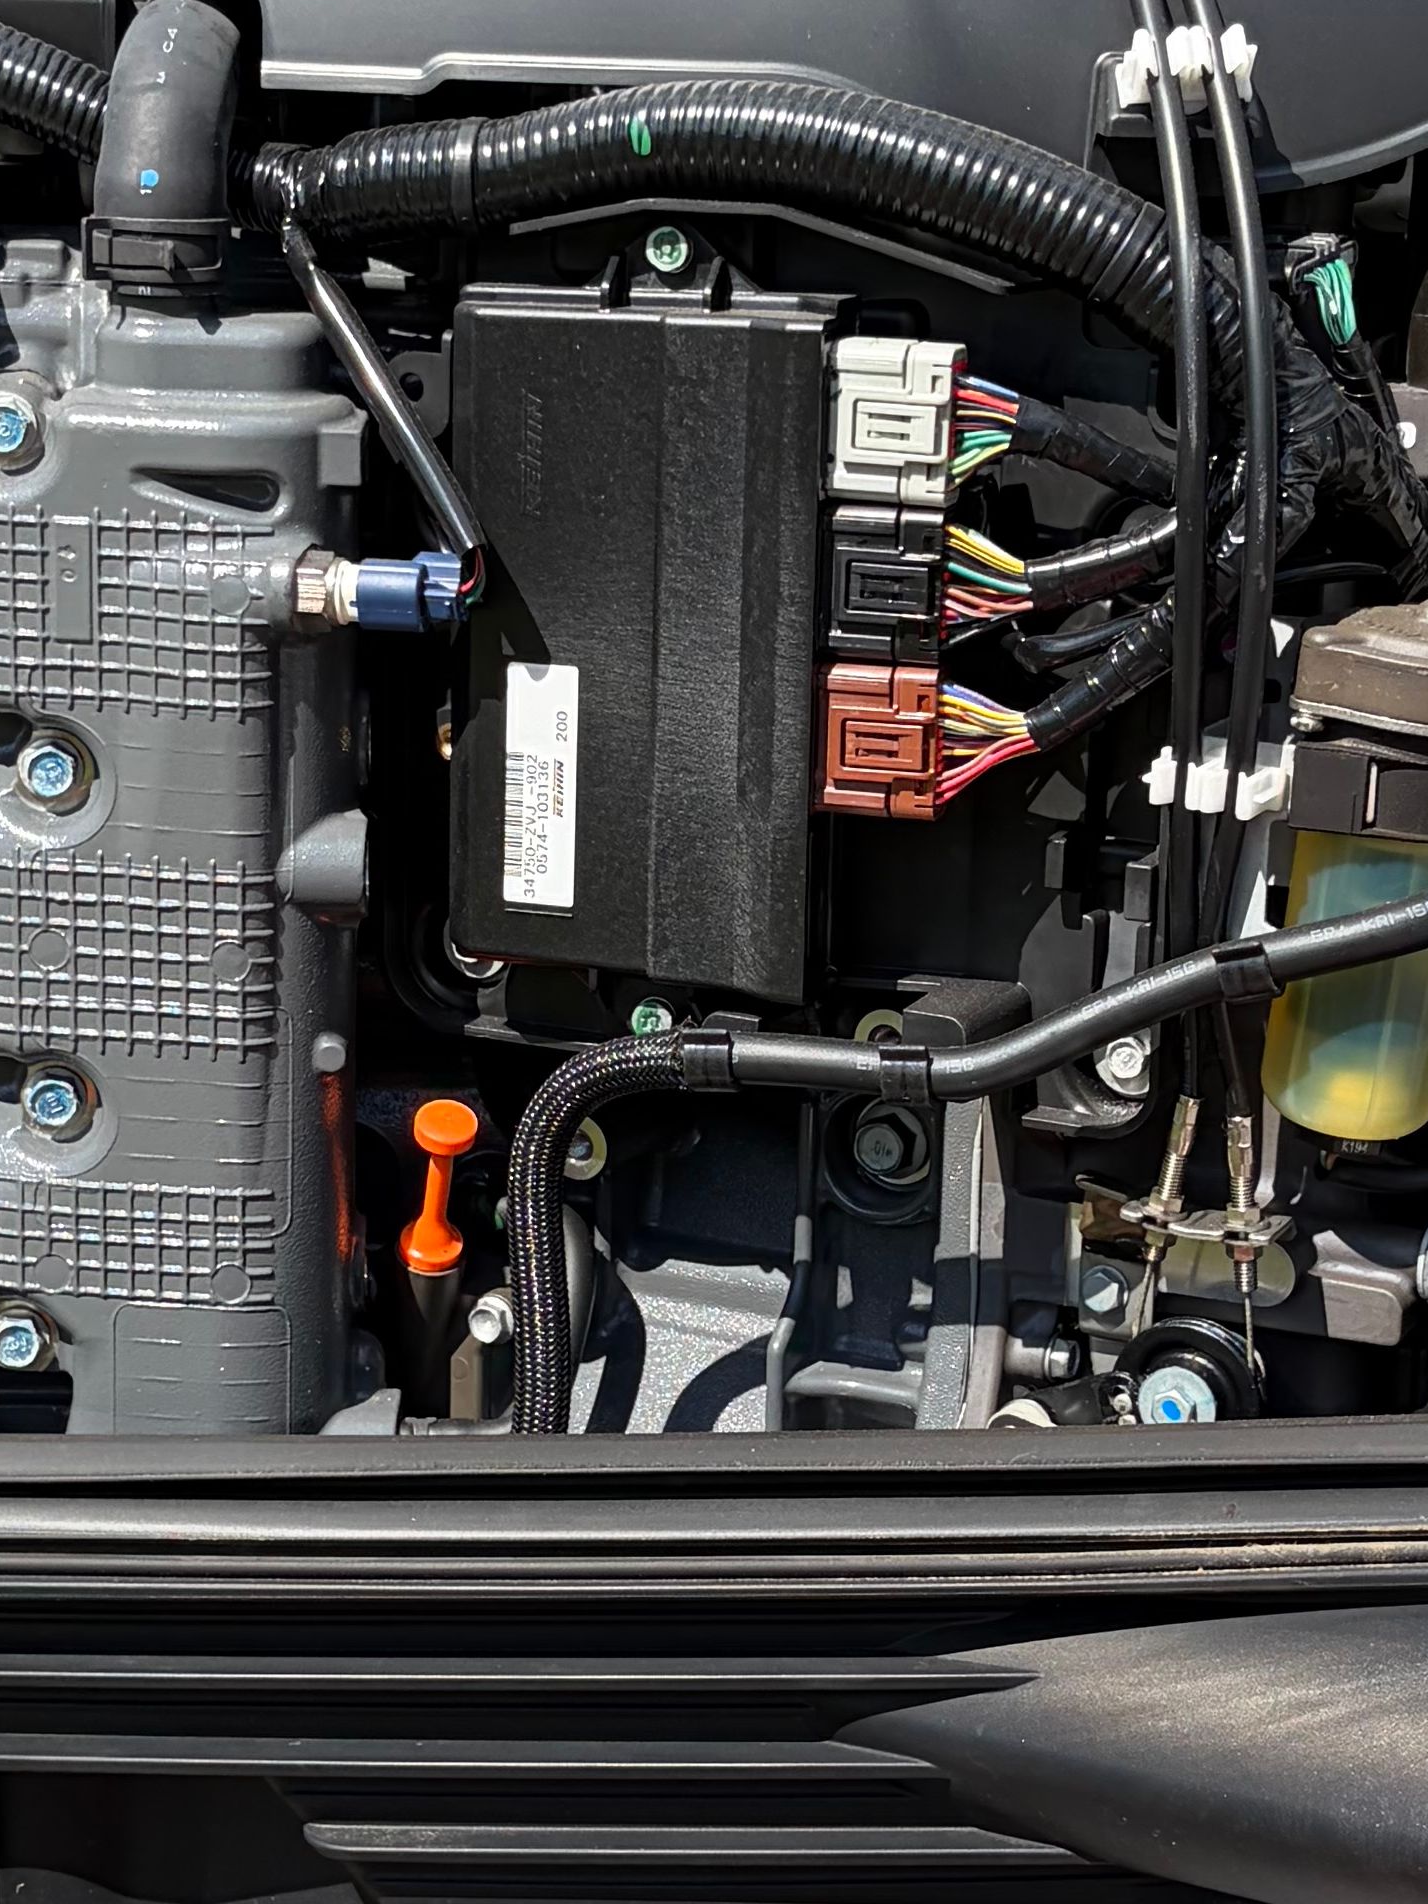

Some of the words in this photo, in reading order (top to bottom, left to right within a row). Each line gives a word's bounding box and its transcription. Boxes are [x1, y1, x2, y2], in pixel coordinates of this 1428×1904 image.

[555, 710, 569, 742] 200
[536, 760, 549, 874] 0574-103136
[552, 758, 565, 818] KEIHIN
